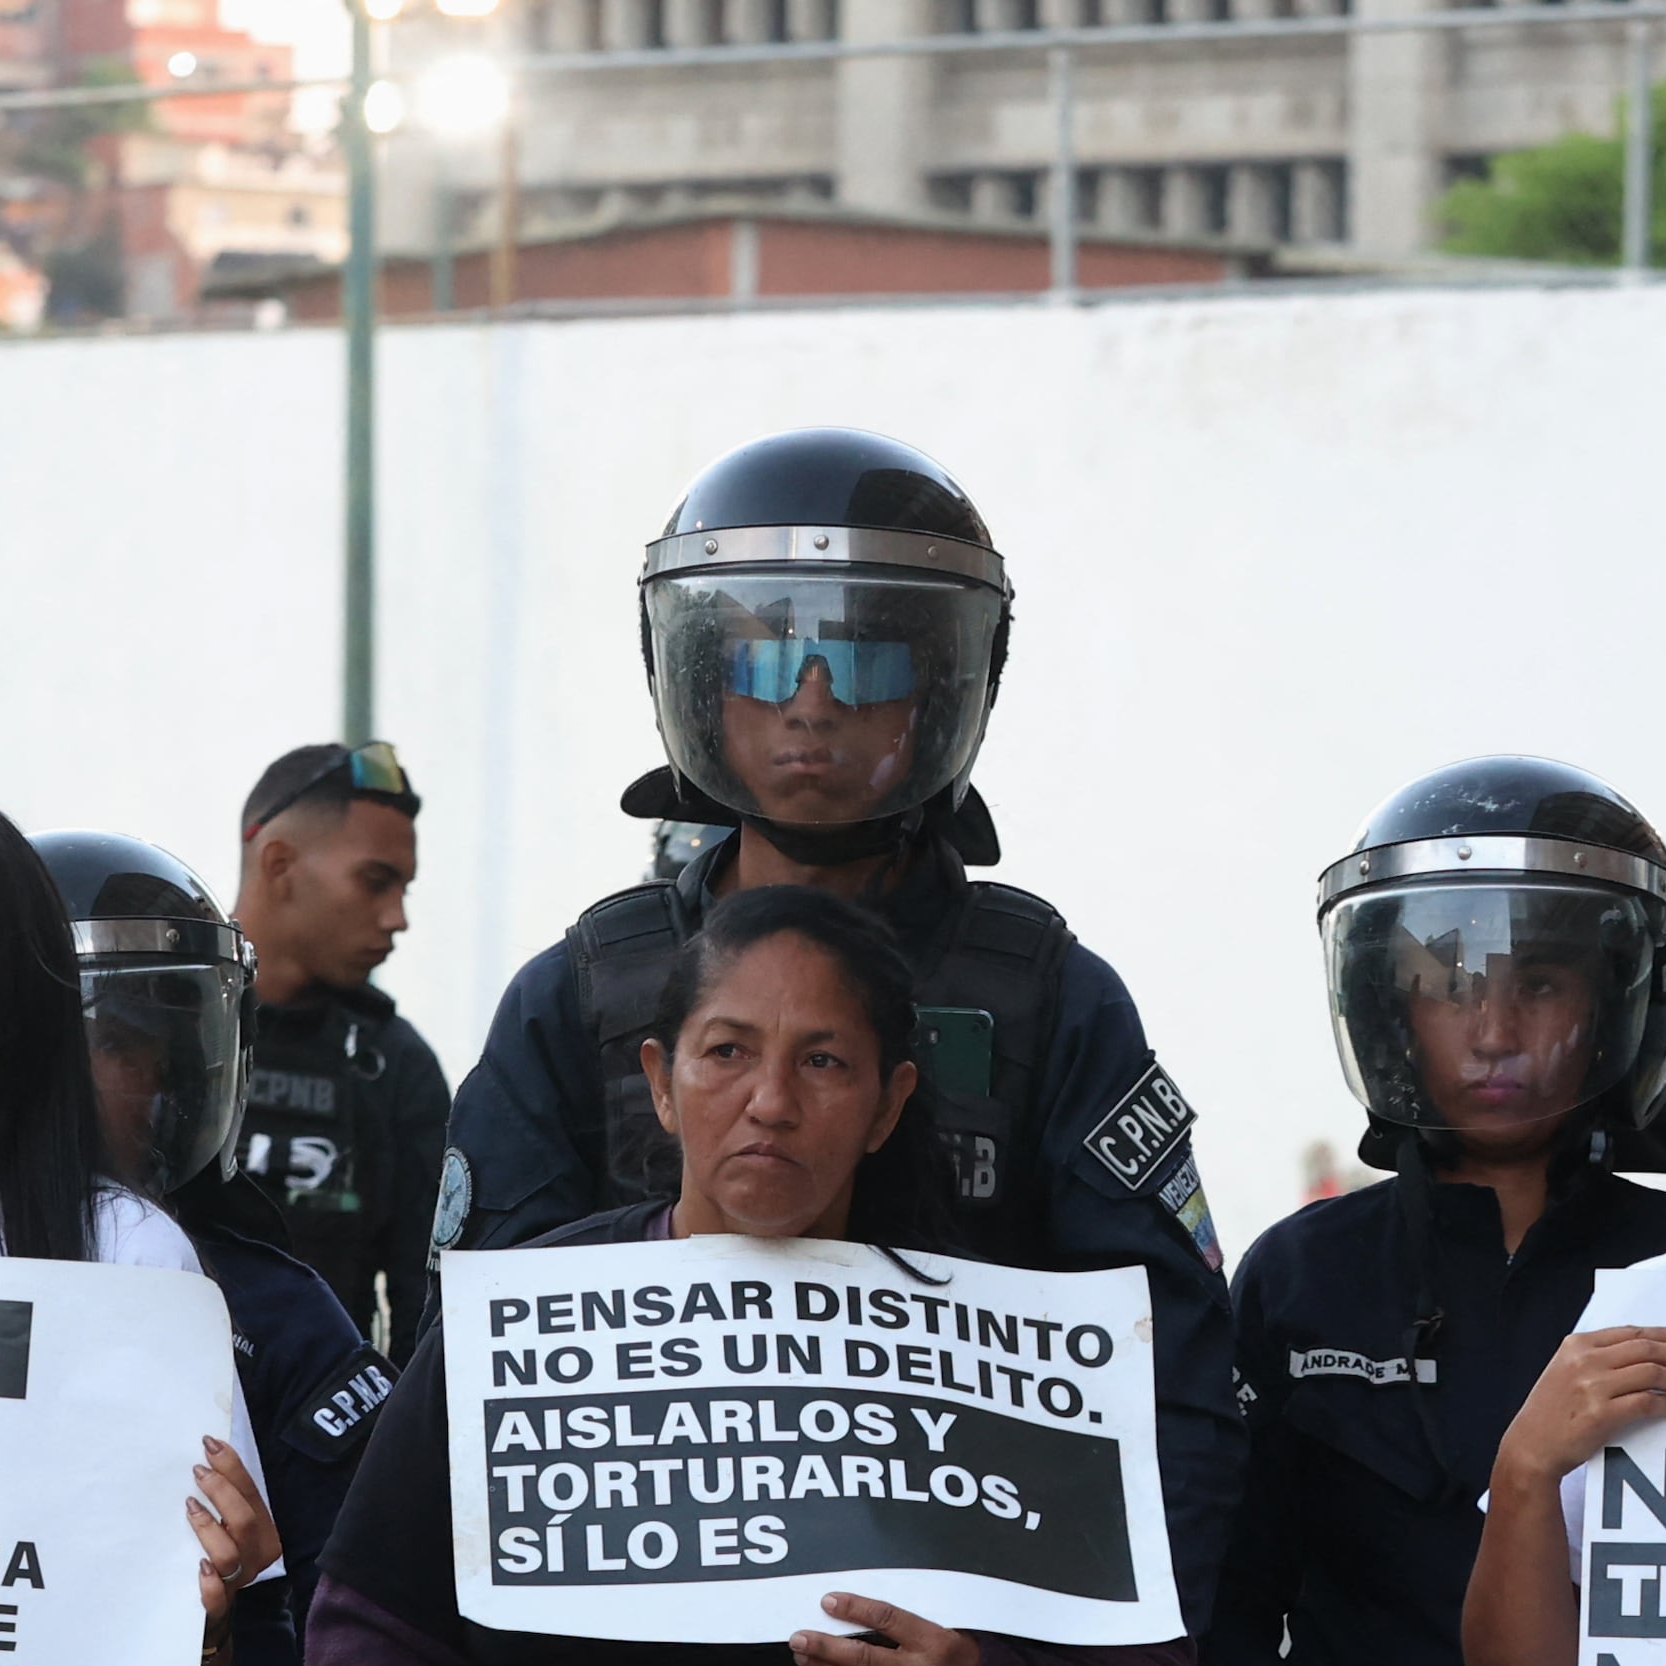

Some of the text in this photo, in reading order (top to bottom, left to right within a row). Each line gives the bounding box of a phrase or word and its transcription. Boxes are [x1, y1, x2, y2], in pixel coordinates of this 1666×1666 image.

[489, 1280, 1114, 1367] PENSAR DISTINTO
[491, 1334, 1103, 1424] NO ES UN DELITO.
[1301, 1354, 1385, 1379] ANDRADE
[492, 1400, 958, 1453] AISLARLOS Y
[492, 1455, 1043, 1531] TORTURARLOS,
[497, 1514, 789, 1575] SÍ LO ES
